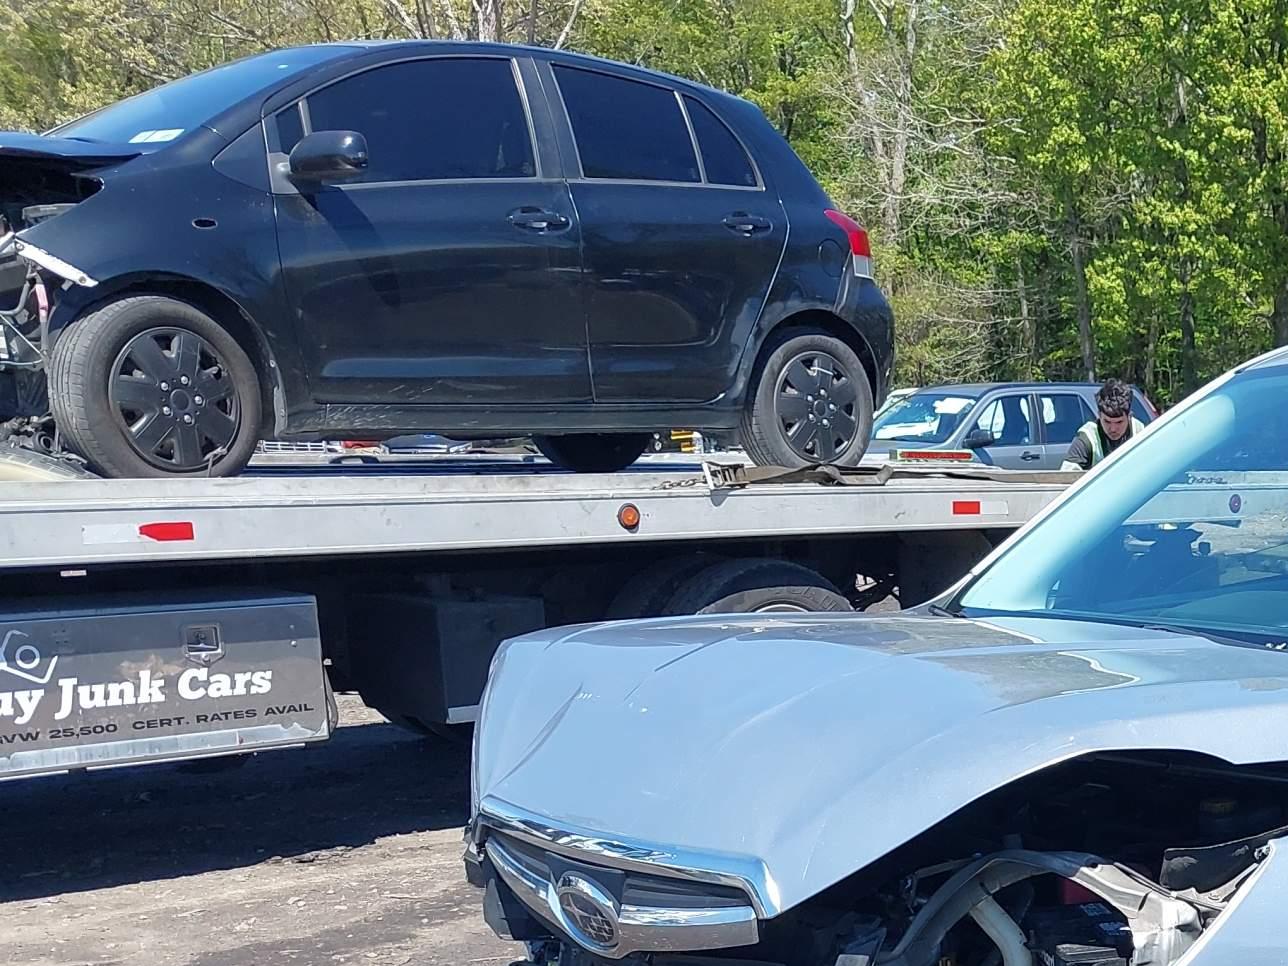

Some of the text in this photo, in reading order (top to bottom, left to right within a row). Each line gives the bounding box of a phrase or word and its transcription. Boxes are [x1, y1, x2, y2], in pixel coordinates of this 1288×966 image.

[54, 670, 166, 720] Junk
[177, 667, 273, 700] Cars
[49, 723, 118, 740] 25,500
[132, 715, 190, 730] CERT.
[196, 708, 257, 724] RATES
[264, 702, 314, 717] AVAIL
